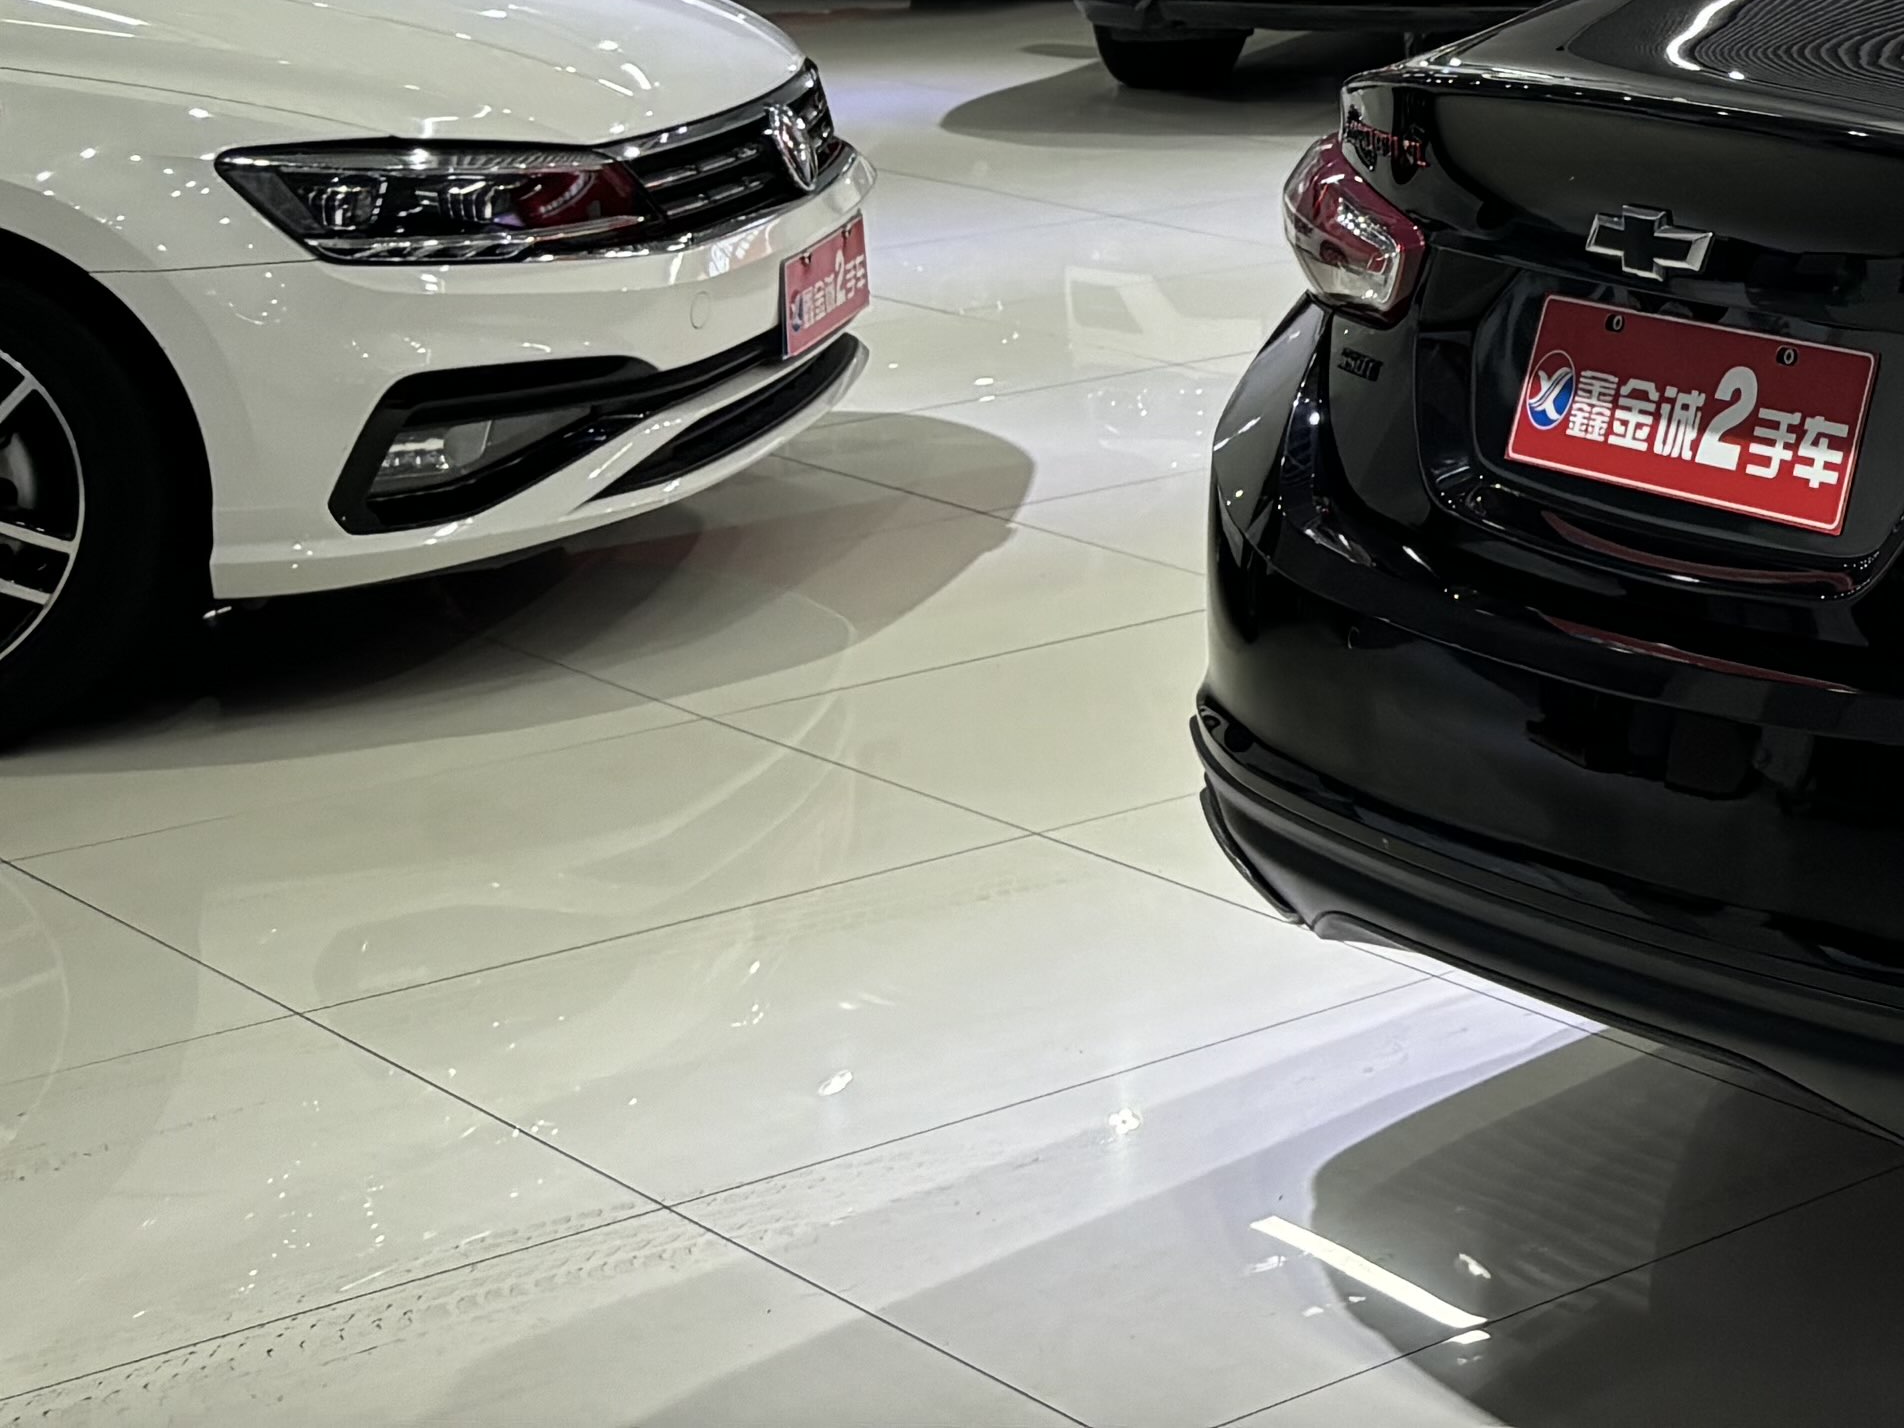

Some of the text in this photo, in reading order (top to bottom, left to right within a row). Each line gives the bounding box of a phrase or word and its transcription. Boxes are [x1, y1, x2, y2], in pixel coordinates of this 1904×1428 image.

[1566, 366, 1850, 489] 鑫金诚2手车
